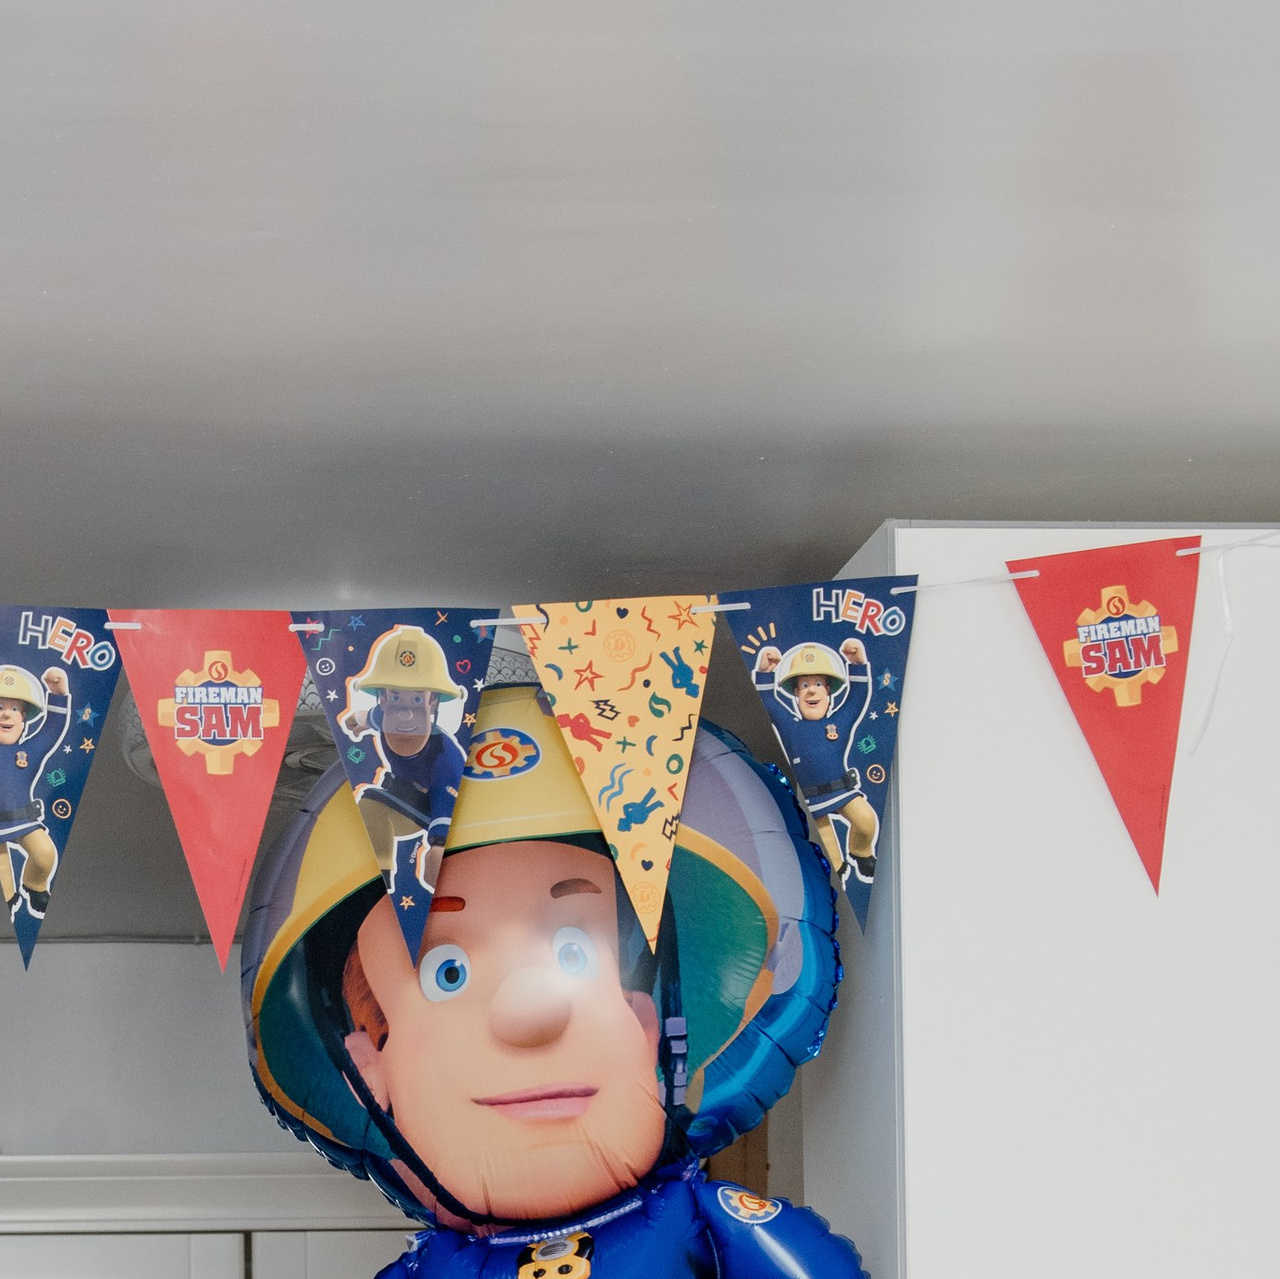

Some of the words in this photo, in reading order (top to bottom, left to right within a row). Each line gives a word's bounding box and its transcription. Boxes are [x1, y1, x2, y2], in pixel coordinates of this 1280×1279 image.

[812, 587, 906, 636] HERO
[1077, 616, 1160, 642] FIREMAN
[18, 611, 116, 671] HERO
[1080, 632, 1166, 678] SAM
[174, 687, 263, 704] FIREMAN
[174, 704, 264, 740] SAM
